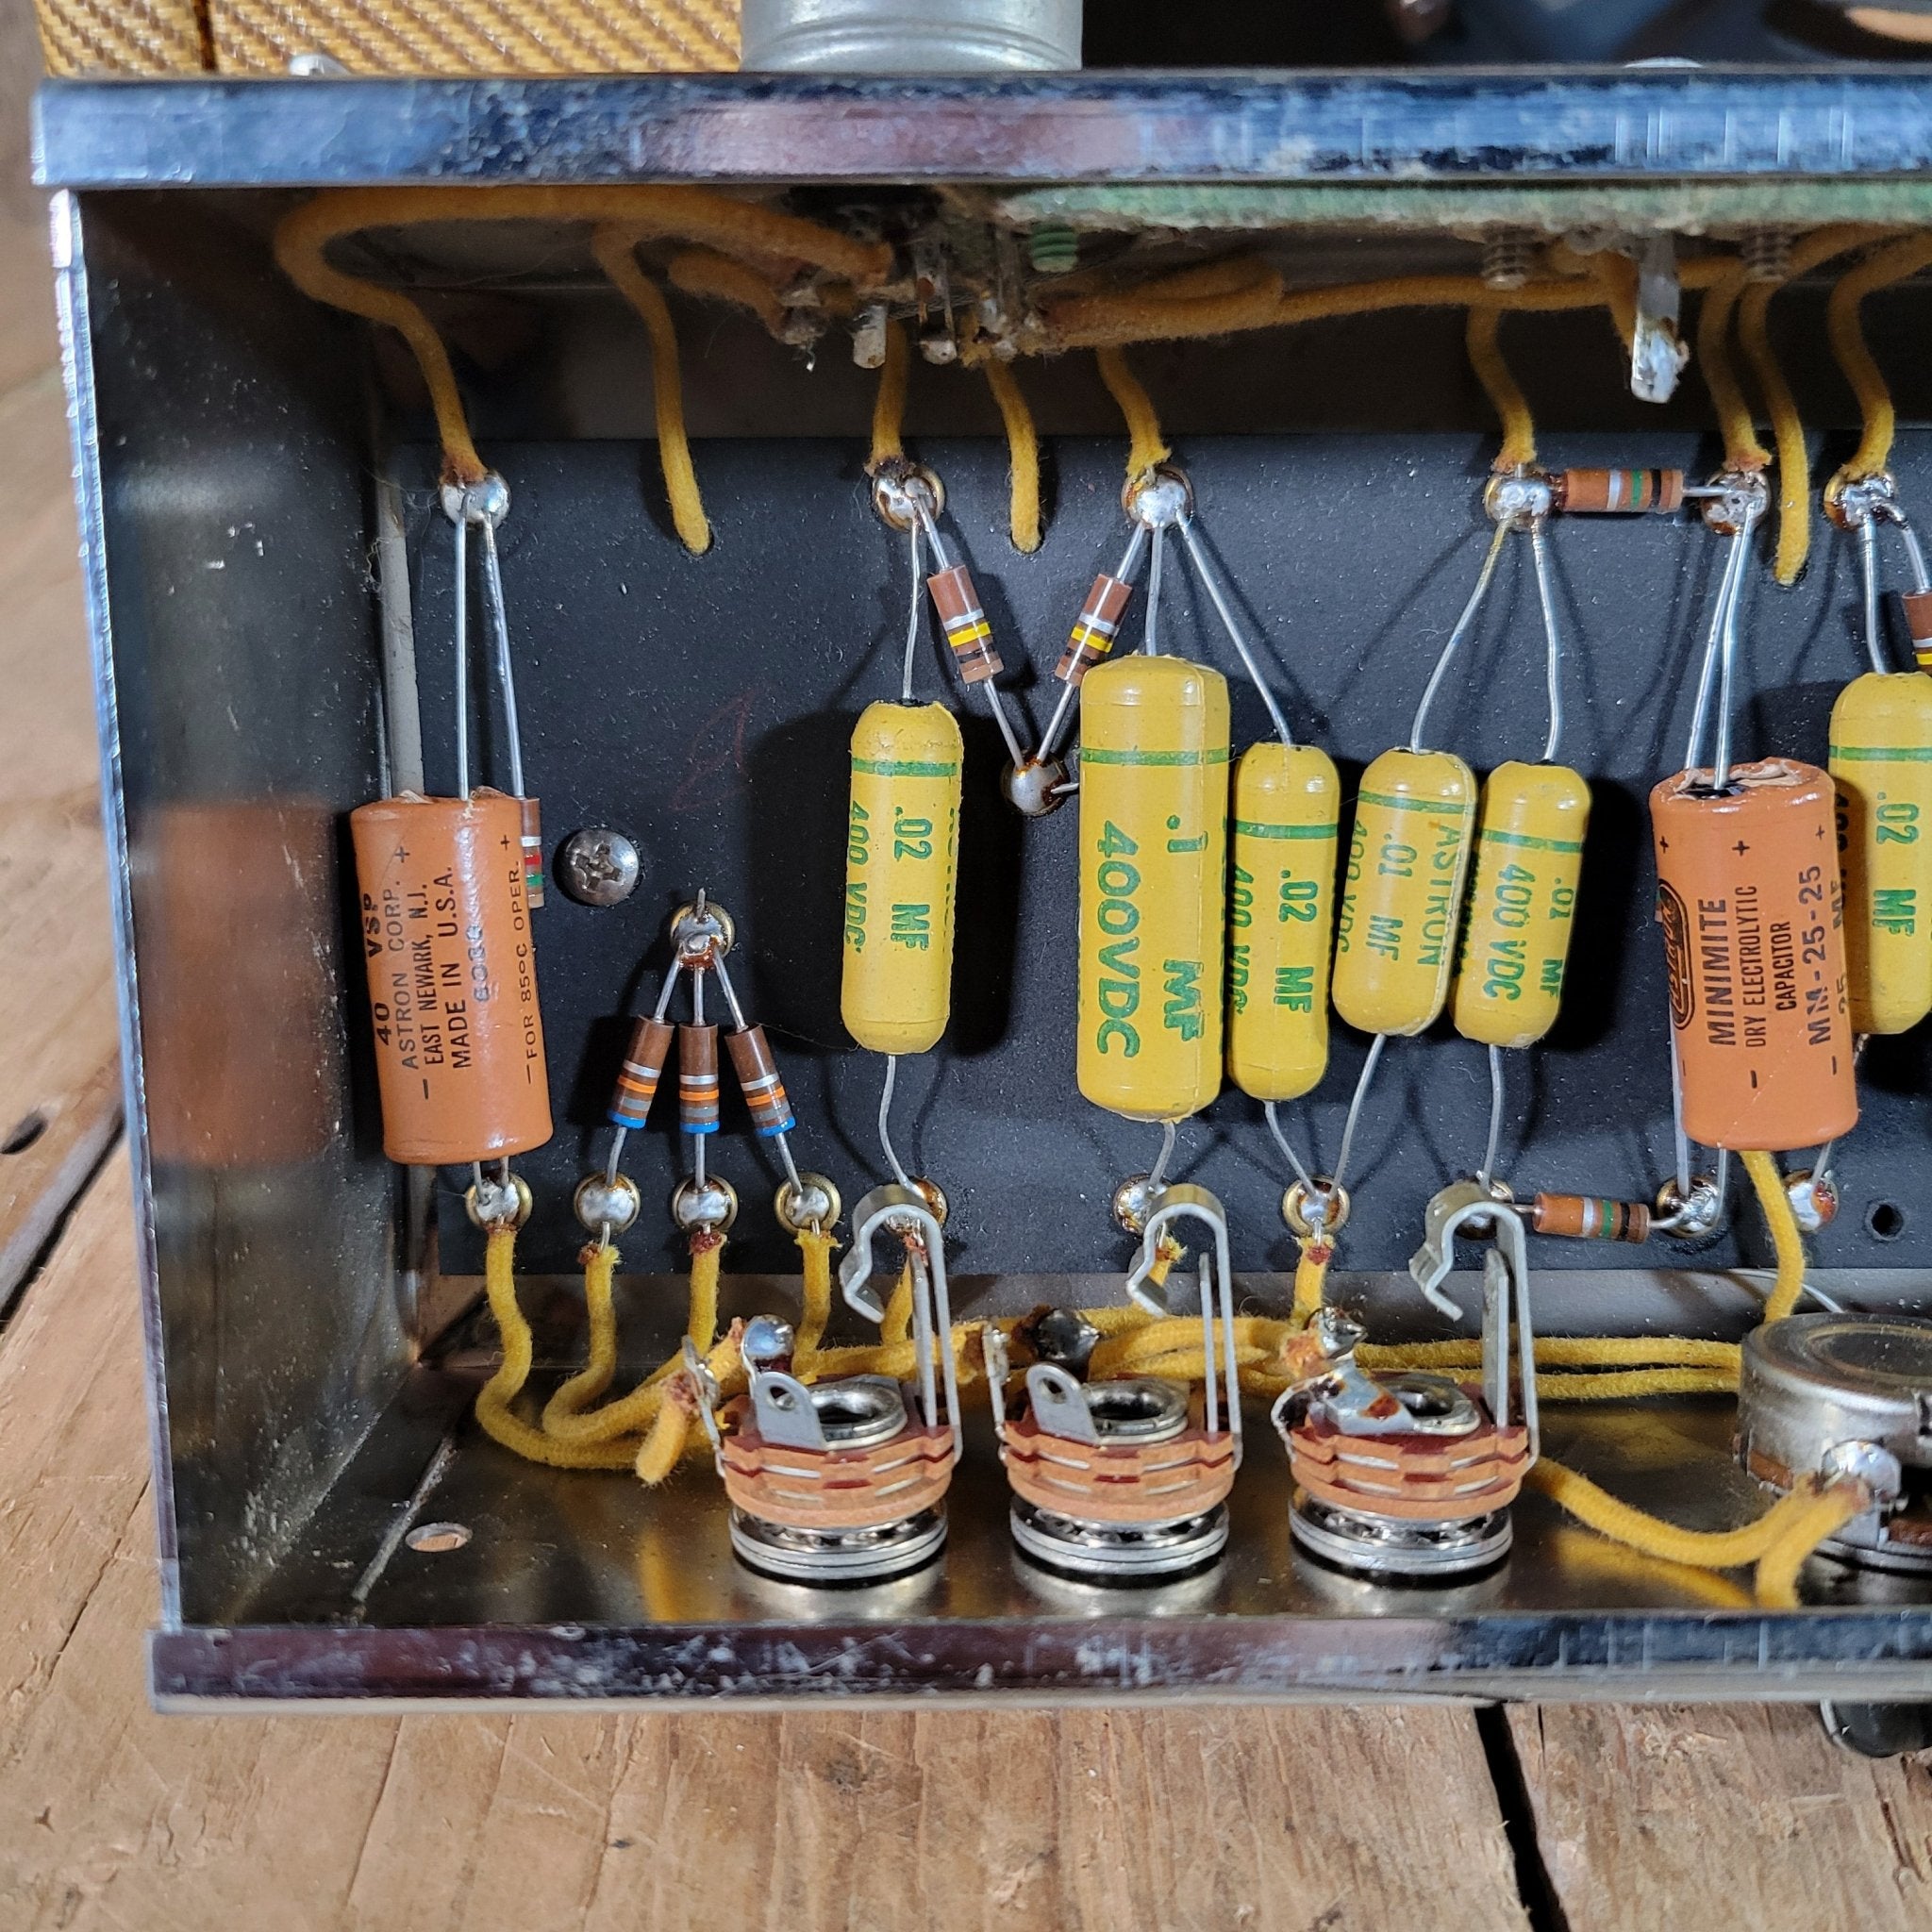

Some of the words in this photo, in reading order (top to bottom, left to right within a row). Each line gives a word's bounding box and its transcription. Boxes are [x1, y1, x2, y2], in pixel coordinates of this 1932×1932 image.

[893, 807, 933, 861] .02
[1166, 814, 1208, 853] .1
[1876, 791, 1919, 844] .02
[1377, 832, 1418, 877] .01
[384, 880, 404, 952] CORP.
[407, 883, 428, 920] N.J.
[434, 866, 458, 937] U.S.A.
[508, 860, 525, 931] OPER.
[1279, 869, 1319, 924] .02
[1416, 824, 1461, 966] ASTRON
[1492, 863, 1536, 928] 400
[1549, 877, 1575, 921] .01
[1872, 889, 1917, 938] MF
[890, 904, 931, 952] MF
[1366, 914, 1404, 961] MF
[1735, 886, 1766, 1007] ELECTROLYTIC
[411, 933, 438, 1011] NEWARK,
[440, 962, 461, 990] IN
[1274, 966, 1315, 1013] MF
[1482, 940, 1527, 1002] VDC
[1540, 958, 1565, 998] MF
[1698, 898, 1737, 1046] MINIMITE
[1770, 921, 1797, 1011] CAPACITOR
[374, 1002, 390, 1046] 40
[393, 973, 418, 1070] ASTRON
[1163, 958, 1205, 1041] MF
[424, 1024, 444, 1067] EAST
[444, 999, 472, 1069] MADE
[525, 1015, 538, 1061] FOR
[1745, 1015, 1766, 1048] DRY
